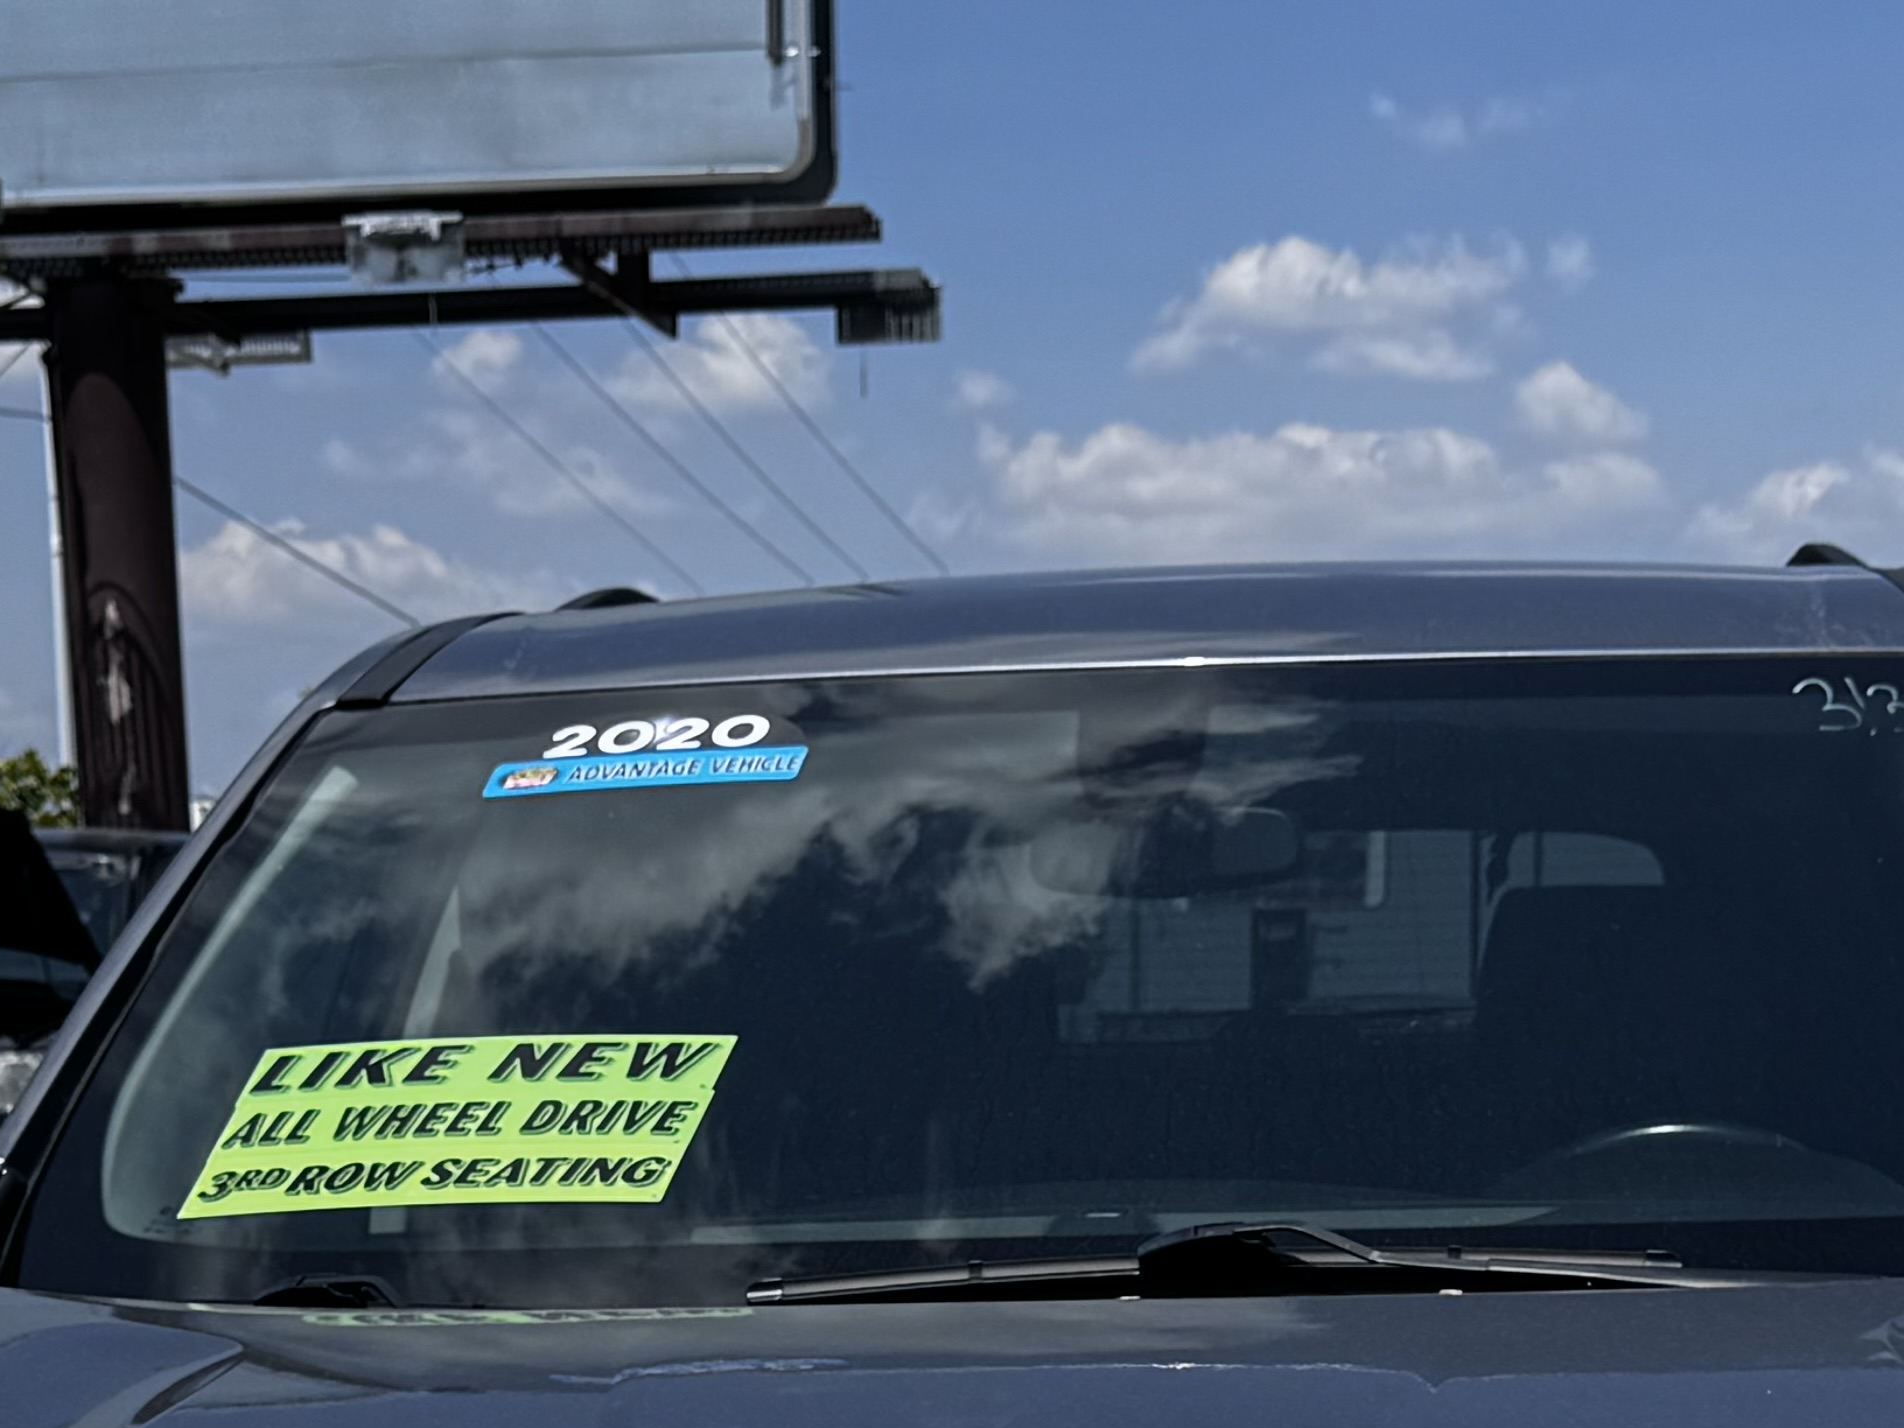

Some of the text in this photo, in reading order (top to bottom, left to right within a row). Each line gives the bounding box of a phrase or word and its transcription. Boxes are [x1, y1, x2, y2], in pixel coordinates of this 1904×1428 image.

[543, 714, 770, 759] 2020
[564, 757, 701, 784] ADVANTAGE
[710, 753, 802, 775] VEHICLE
[249, 1042, 721, 1097] LIKE NEW
[221, 1100, 698, 1150] ALL WHEEL DRIVE
[197, 1157, 672, 1203] 3RD ROW SEATING
